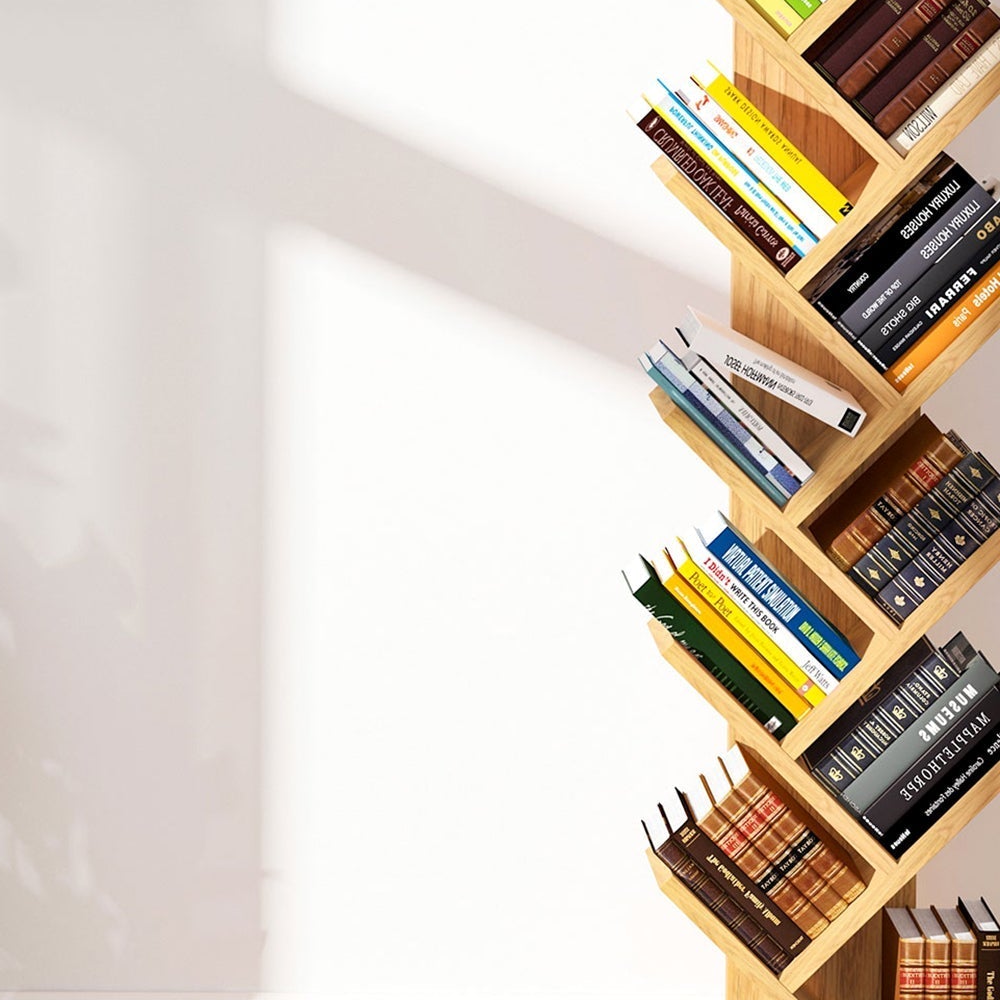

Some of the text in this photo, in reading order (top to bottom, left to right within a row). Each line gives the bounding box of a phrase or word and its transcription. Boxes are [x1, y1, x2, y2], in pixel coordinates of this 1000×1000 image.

[688, 571, 707, 592] Poet
[714, 596, 733, 617] Poet
[708, 562, 731, 586] Didn't
[730, 583, 750, 604] WRITE
[748, 601, 763, 617] THIS
[760, 614, 779, 634] BOOK
[722, 543, 801, 623] VIRTUAL PATIENT SIMULATION
[800, 660, 830, 689] Jeff Watts
[986, 971, 996, 985] The
